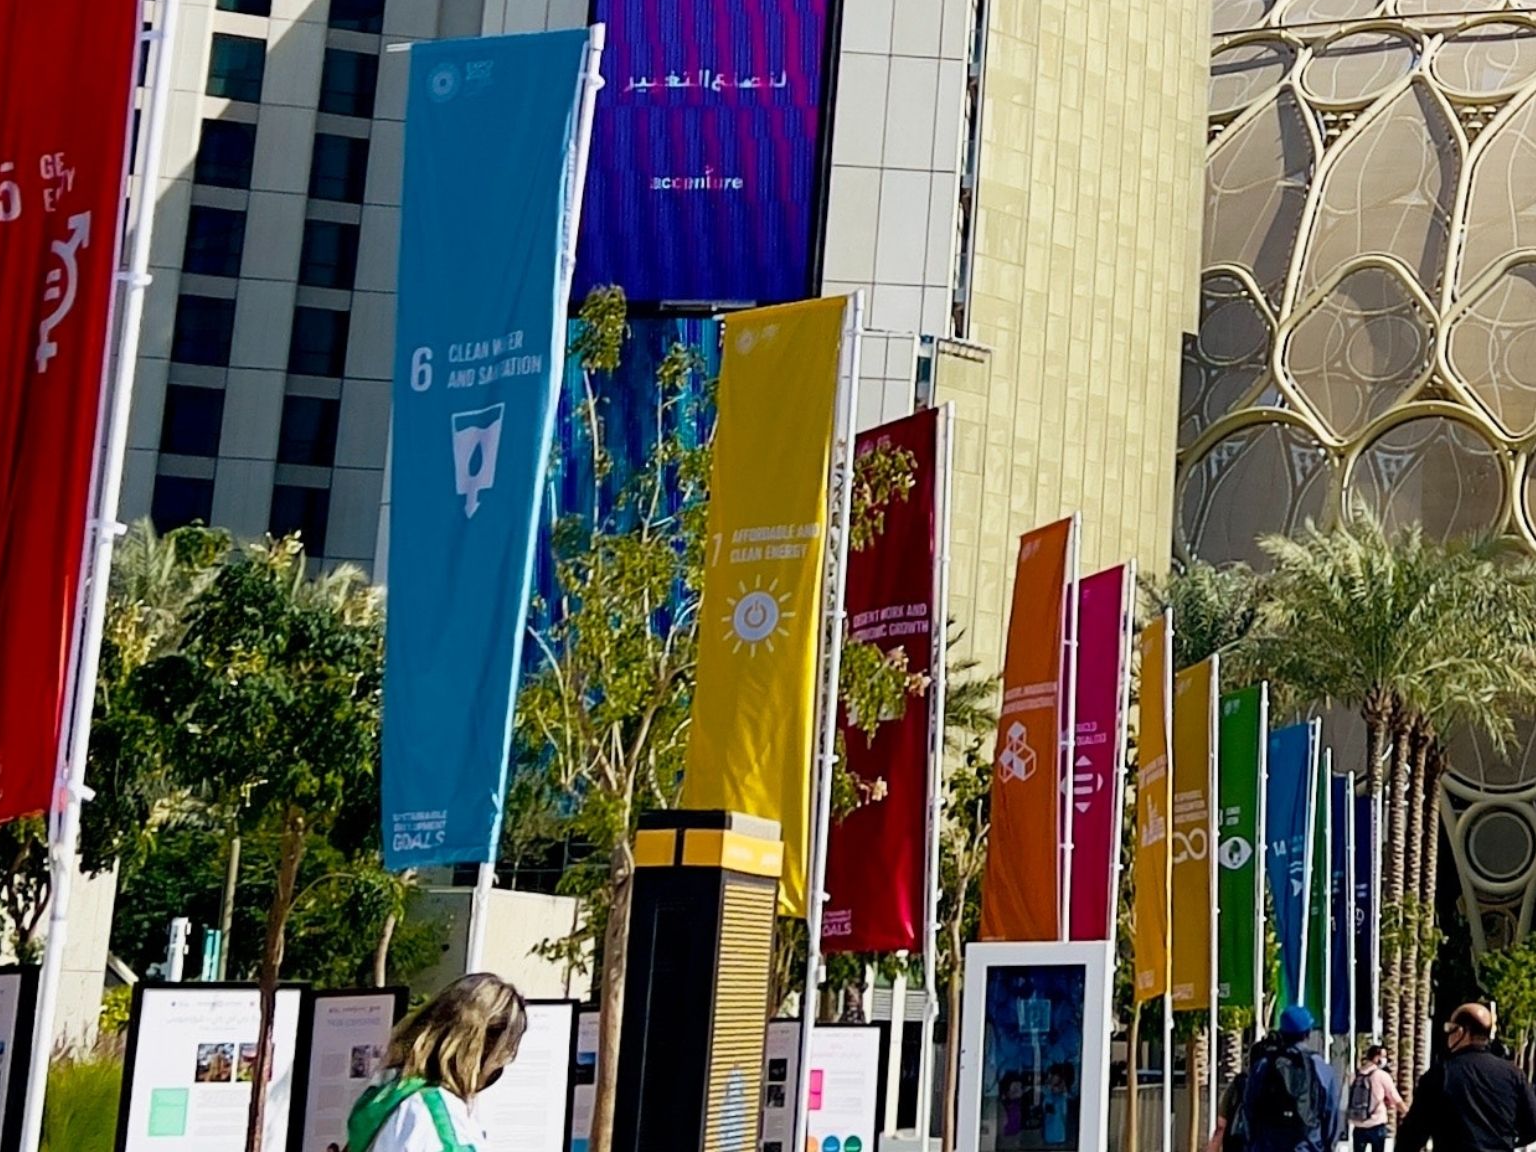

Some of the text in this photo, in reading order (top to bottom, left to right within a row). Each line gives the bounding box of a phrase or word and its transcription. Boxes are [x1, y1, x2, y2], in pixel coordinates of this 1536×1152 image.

[650, 170, 743, 190] accenture
[448, 340, 489, 363] CLEAN
[410, 346, 433, 392] 6
[447, 367, 476, 389] AND
[906, 603, 927, 617] AND
[888, 620, 929, 636] GROWTH
[393, 831, 446, 851] GOALS
